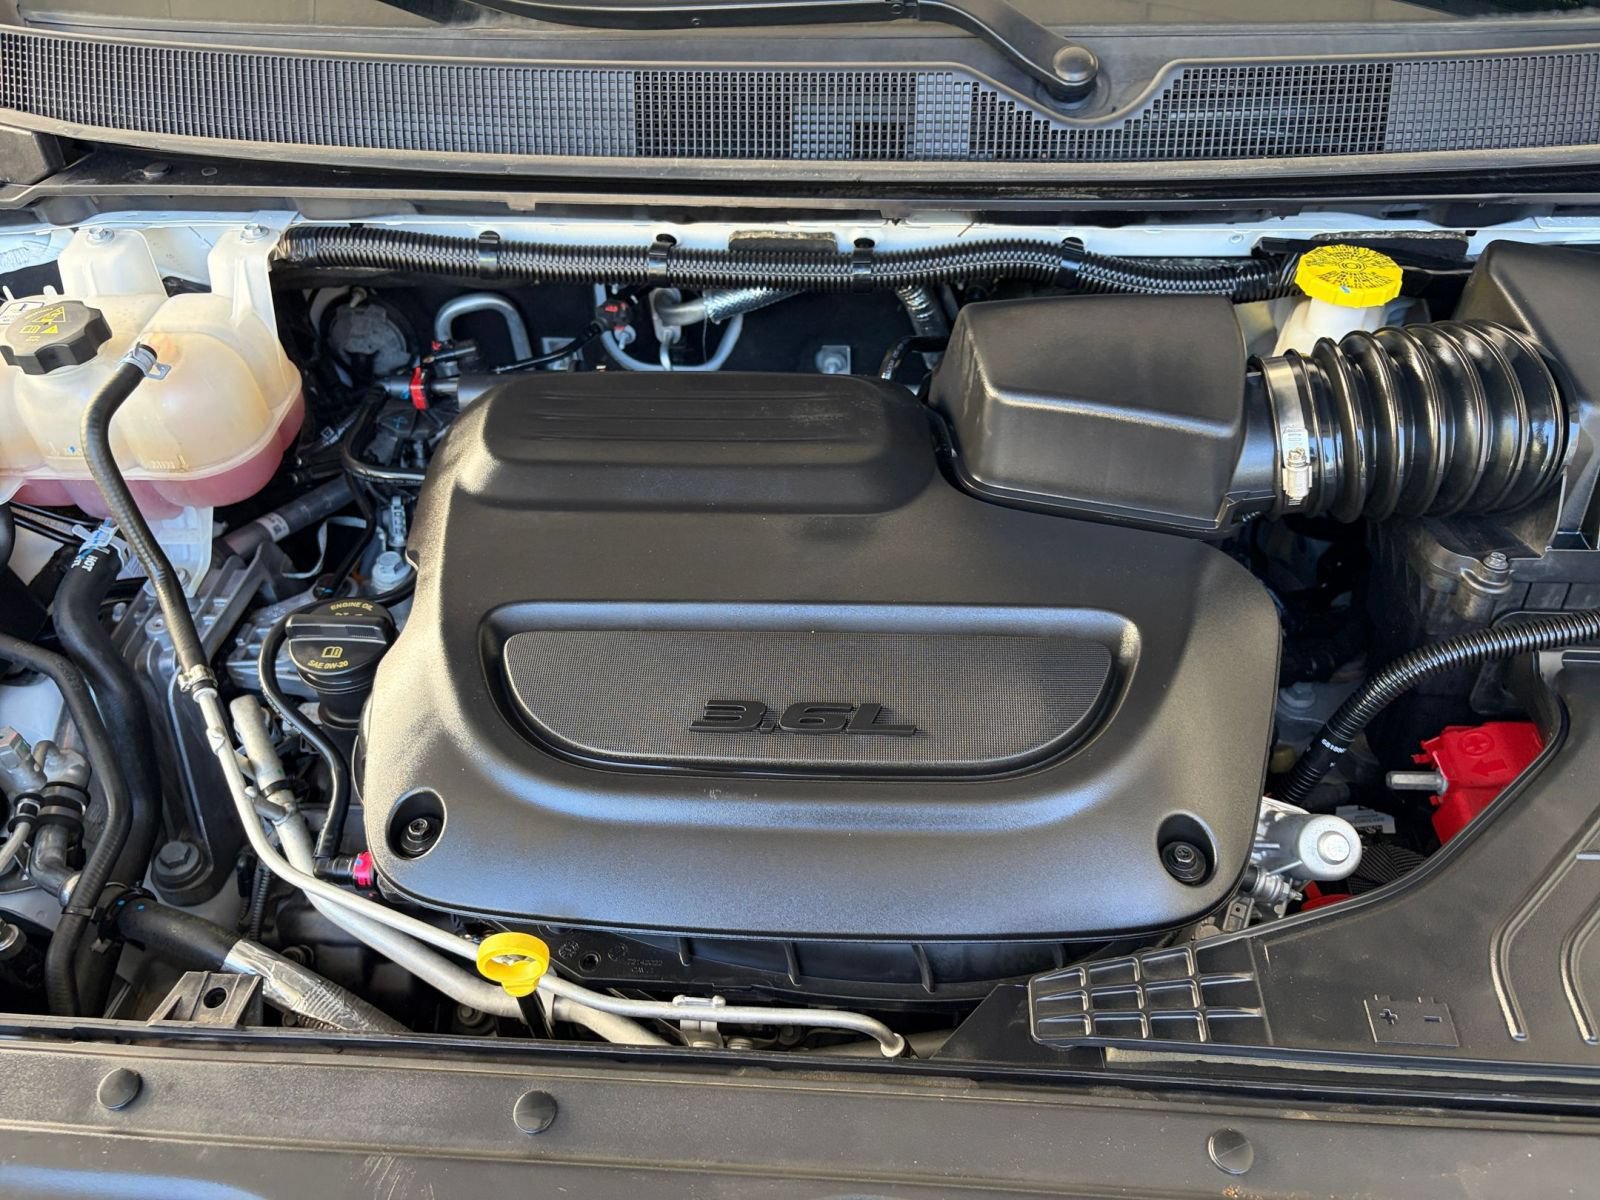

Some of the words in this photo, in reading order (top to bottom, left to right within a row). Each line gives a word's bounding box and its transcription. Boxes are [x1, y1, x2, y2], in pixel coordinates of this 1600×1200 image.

[81, 554, 99, 572] HOT
[330, 601, 361, 611] ENGINE
[308, 659, 323, 669] SAE
[689, 699, 917, 737] 3.6L
